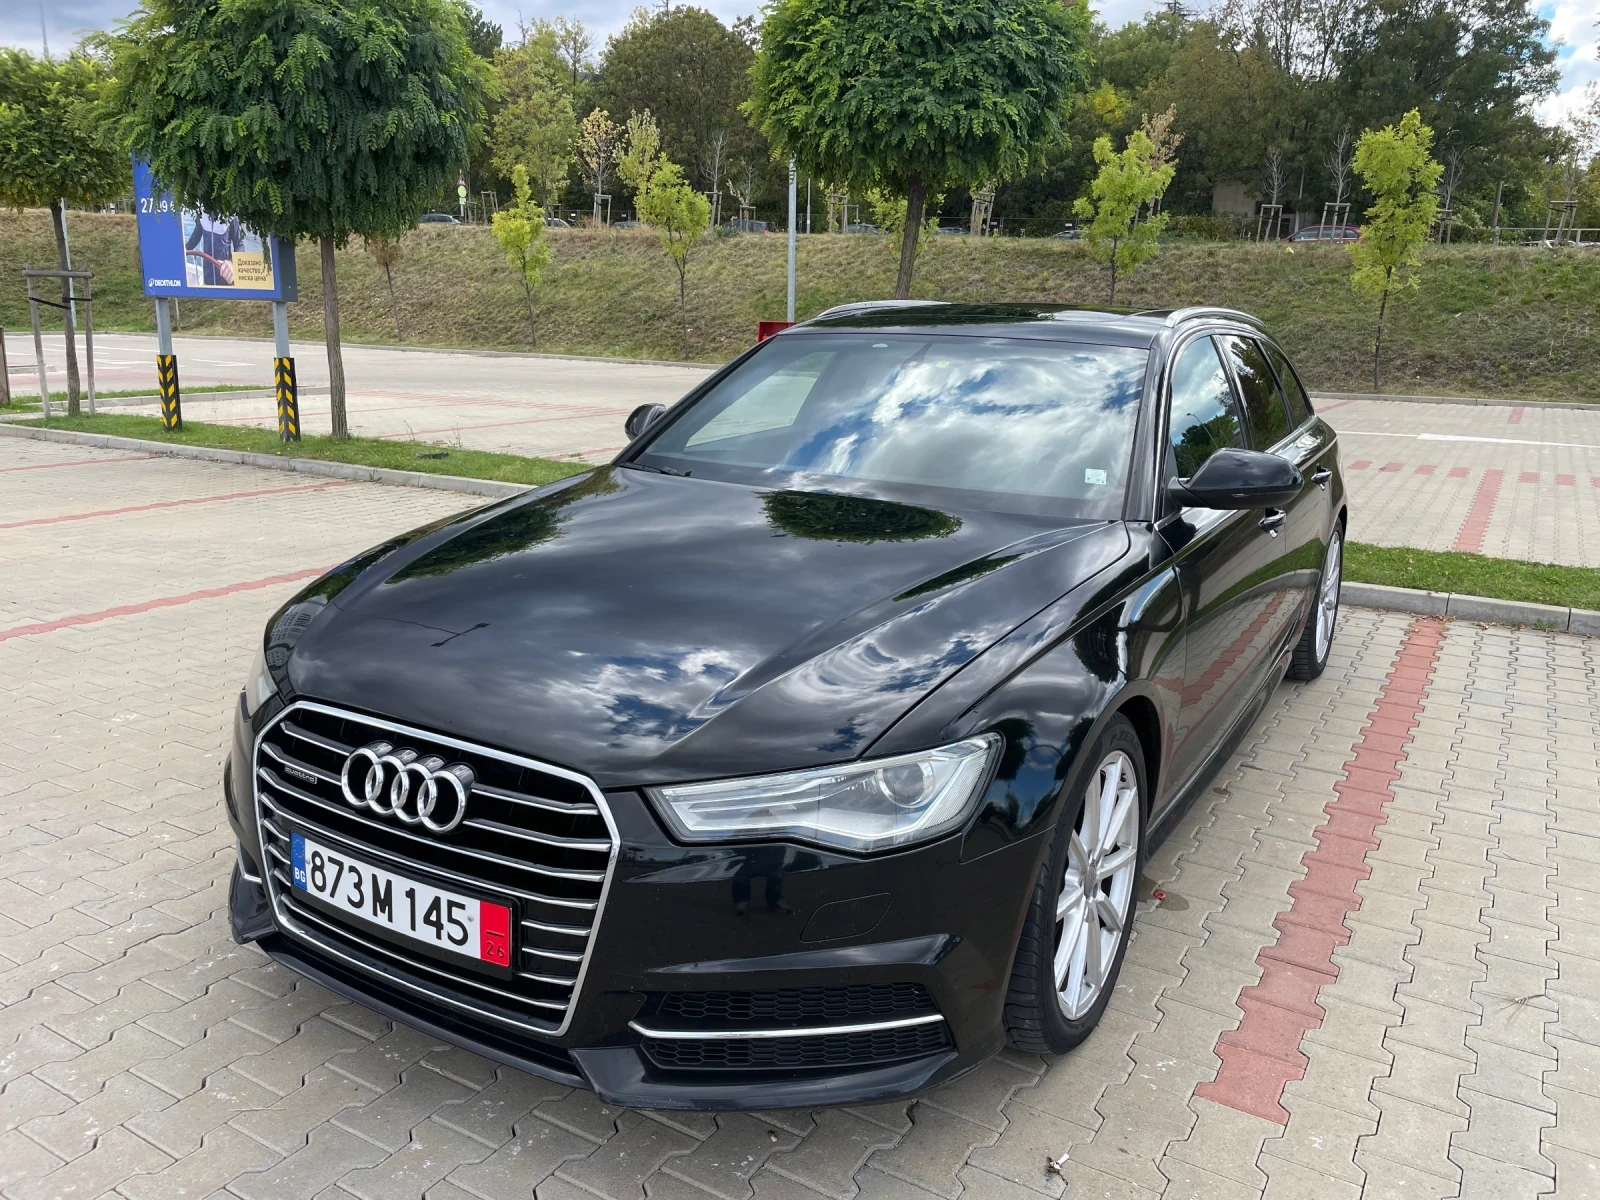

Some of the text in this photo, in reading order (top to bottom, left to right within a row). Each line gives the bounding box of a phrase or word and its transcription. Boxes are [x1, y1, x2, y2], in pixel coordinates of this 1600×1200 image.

[237, 258, 262, 267] Доказано
[154, 279, 181, 287] DECATHLON
[284, 767, 315, 783] quattro
[294, 867, 306, 883] BG
[310, 850, 469, 946] 873 M 145
[486, 941, 505, 959] 26
